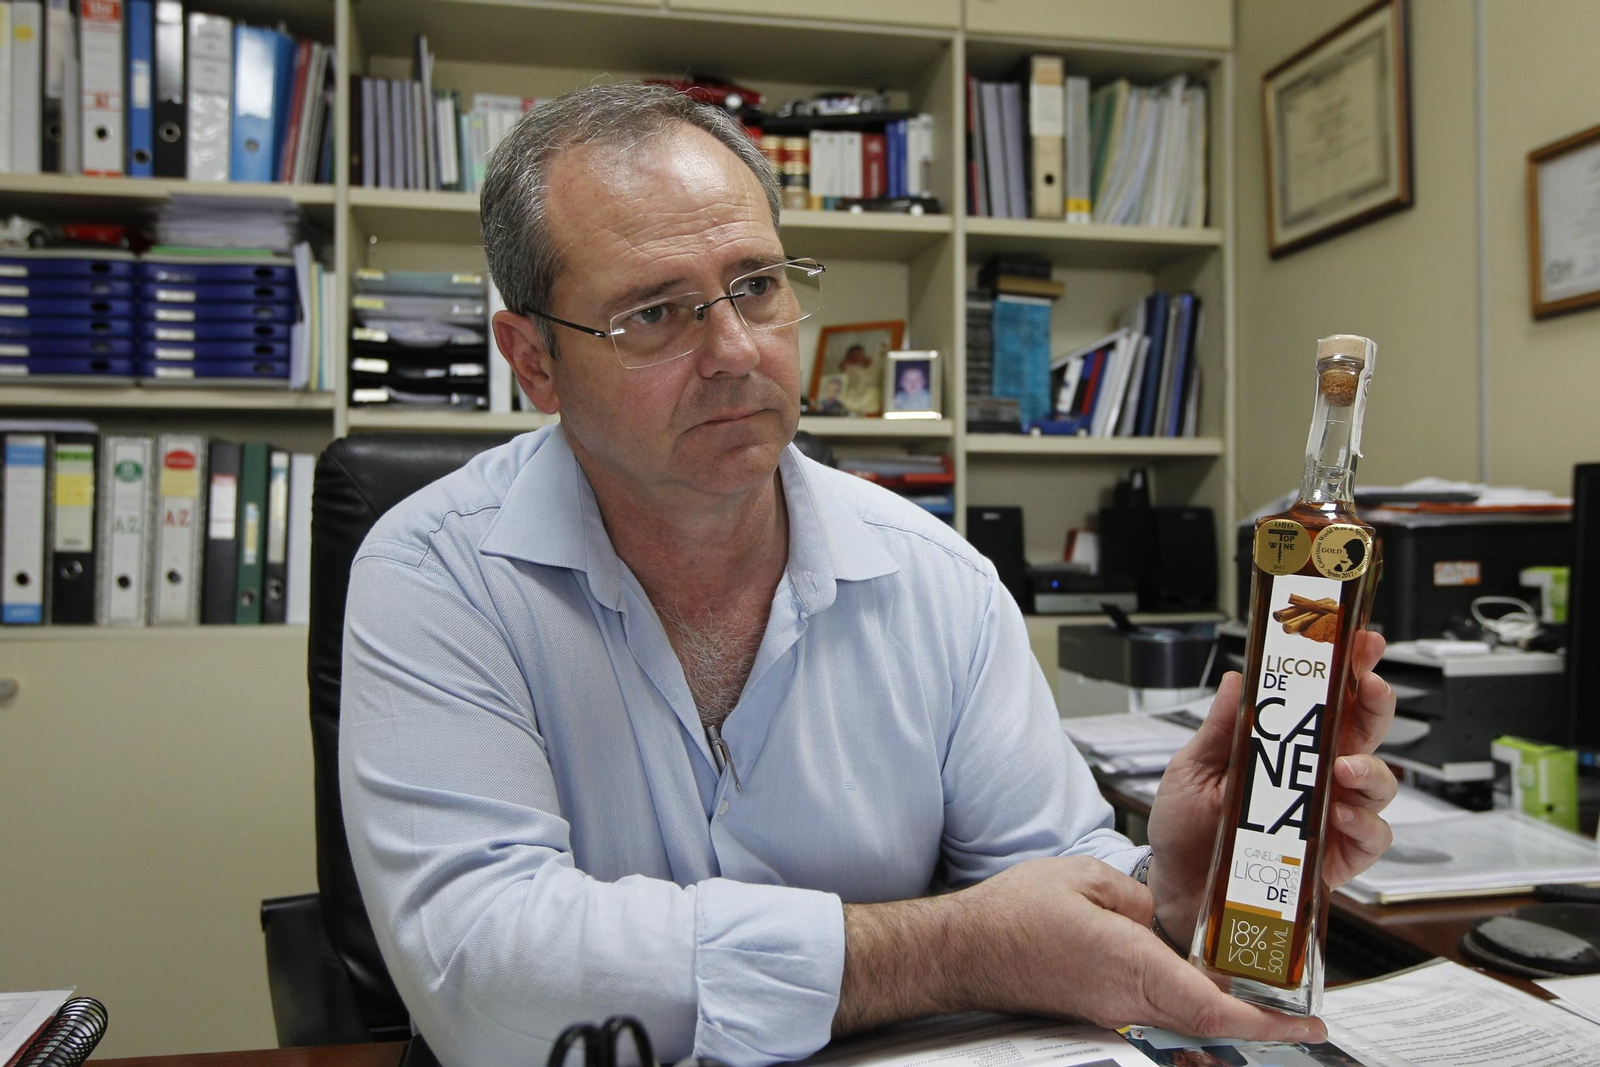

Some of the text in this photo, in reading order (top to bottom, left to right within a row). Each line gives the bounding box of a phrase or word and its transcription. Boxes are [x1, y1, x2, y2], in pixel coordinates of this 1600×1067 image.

[1268, 528, 1298, 543] TOP
[1318, 528, 1334, 541] World
[1353, 528, 1368, 543] Spirits
[1268, 541, 1295, 551] WINE
[1325, 568, 1341, 578] Spain
[1266, 655, 1327, 679] LICOR
[1263, 672, 1288, 691] DE
[1244, 848, 1282, 863] CANELA
[1234, 861, 1291, 888] LICOR
[1291, 866, 1300, 877] DE
[1266, 886, 1289, 903] DE
[1230, 919, 1268, 950] 18%
[1229, 946, 1267, 971] VOL.
[1269, 927, 1289, 975] 500 ML
